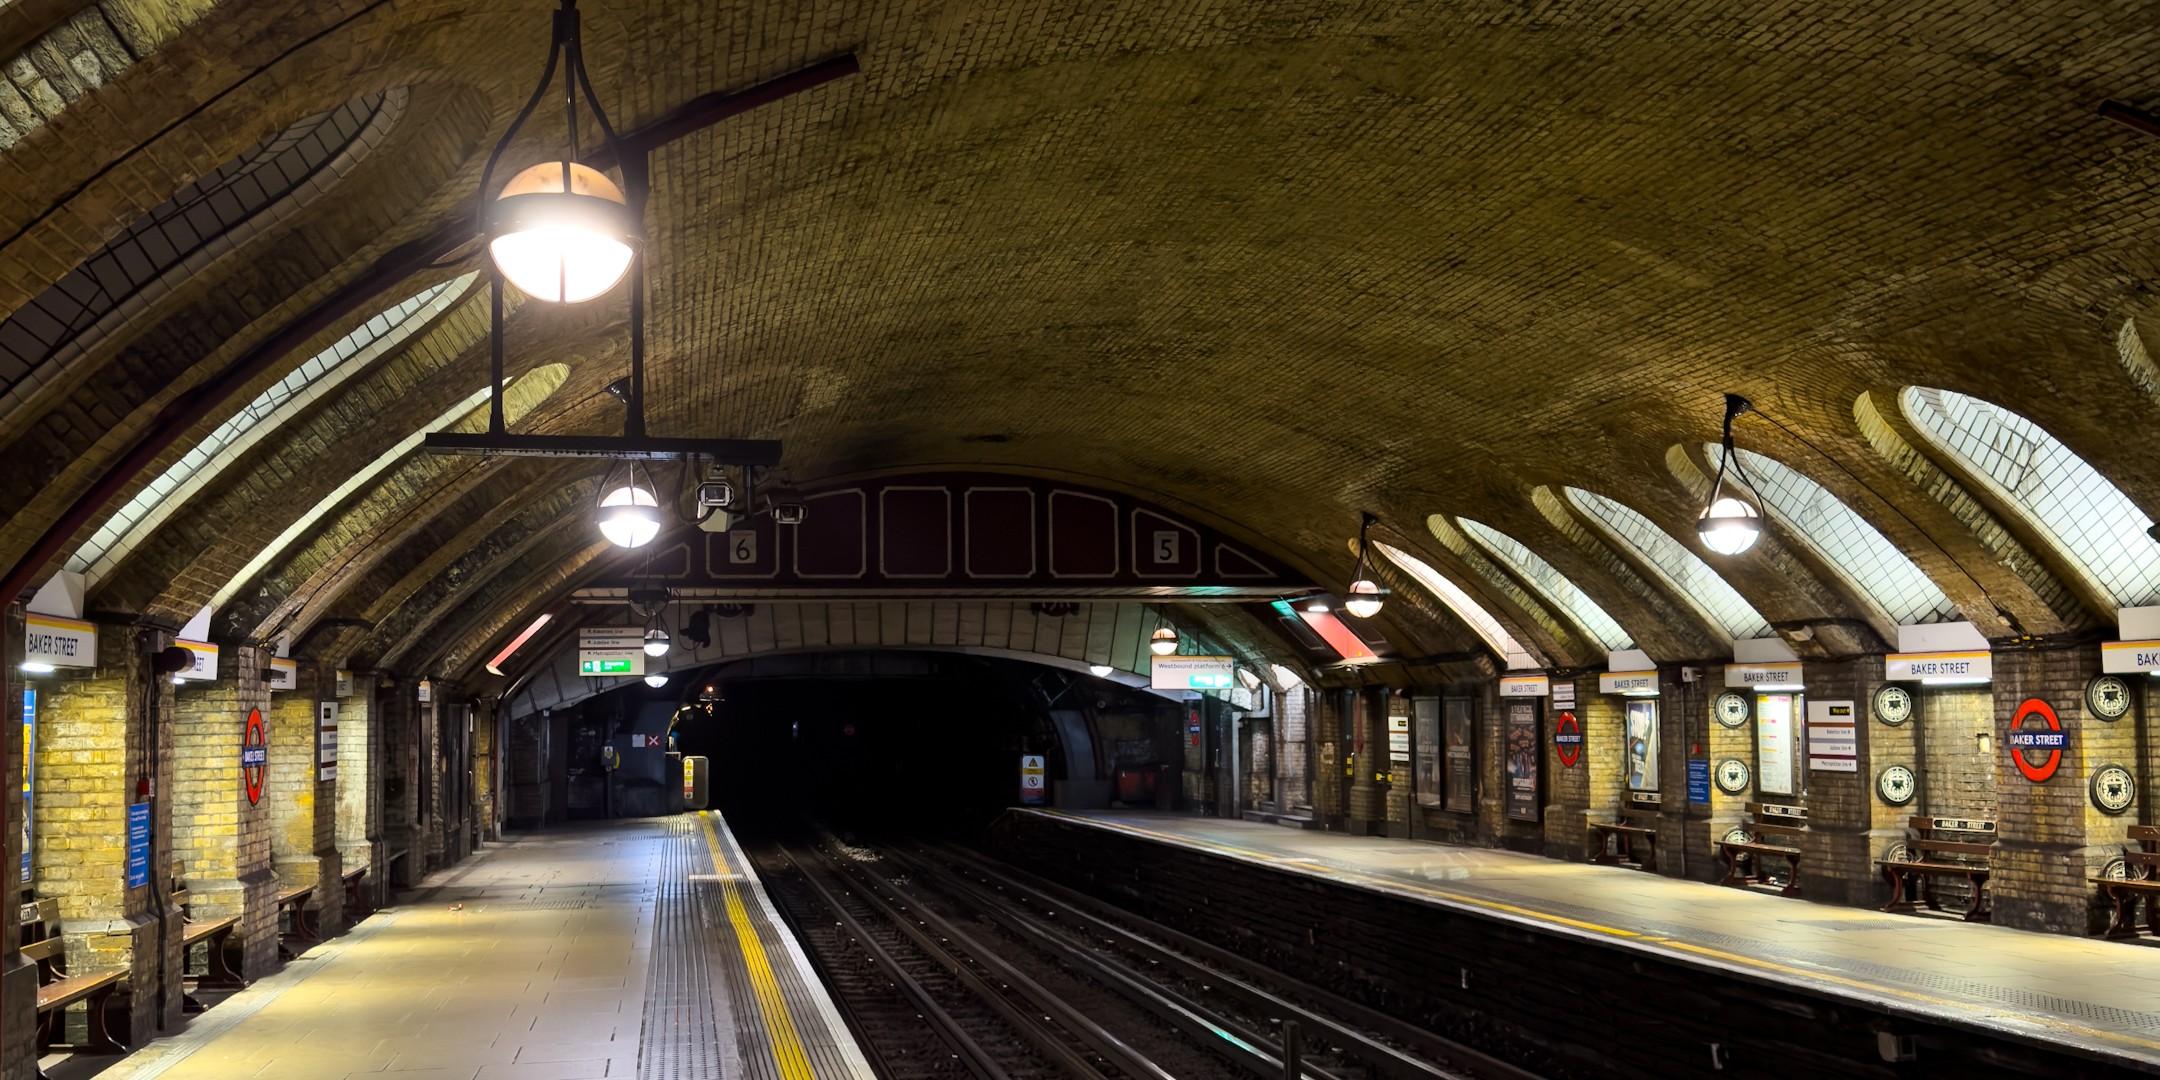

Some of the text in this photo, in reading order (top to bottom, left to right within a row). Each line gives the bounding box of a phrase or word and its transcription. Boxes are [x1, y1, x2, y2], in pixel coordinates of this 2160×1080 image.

[736, 538, 750, 561] 6
[1160, 539, 1173, 561] 5
[29, 633, 78, 657] BAKER STREET
[2137, 652, 2160, 666] BAK
[1911, 662, 1970, 675] BAKER STREET
[1743, 671, 1789, 683] BAKER STREET
[1511, 684, 1538, 693] BAKER STREET
[1614, 679, 1649, 689] BAKER STREET
[2010, 734, 2063, 746] BAKER STREET
[1941, 820, 1958, 829] BAKER
[1966, 821, 1985, 830] STREET
